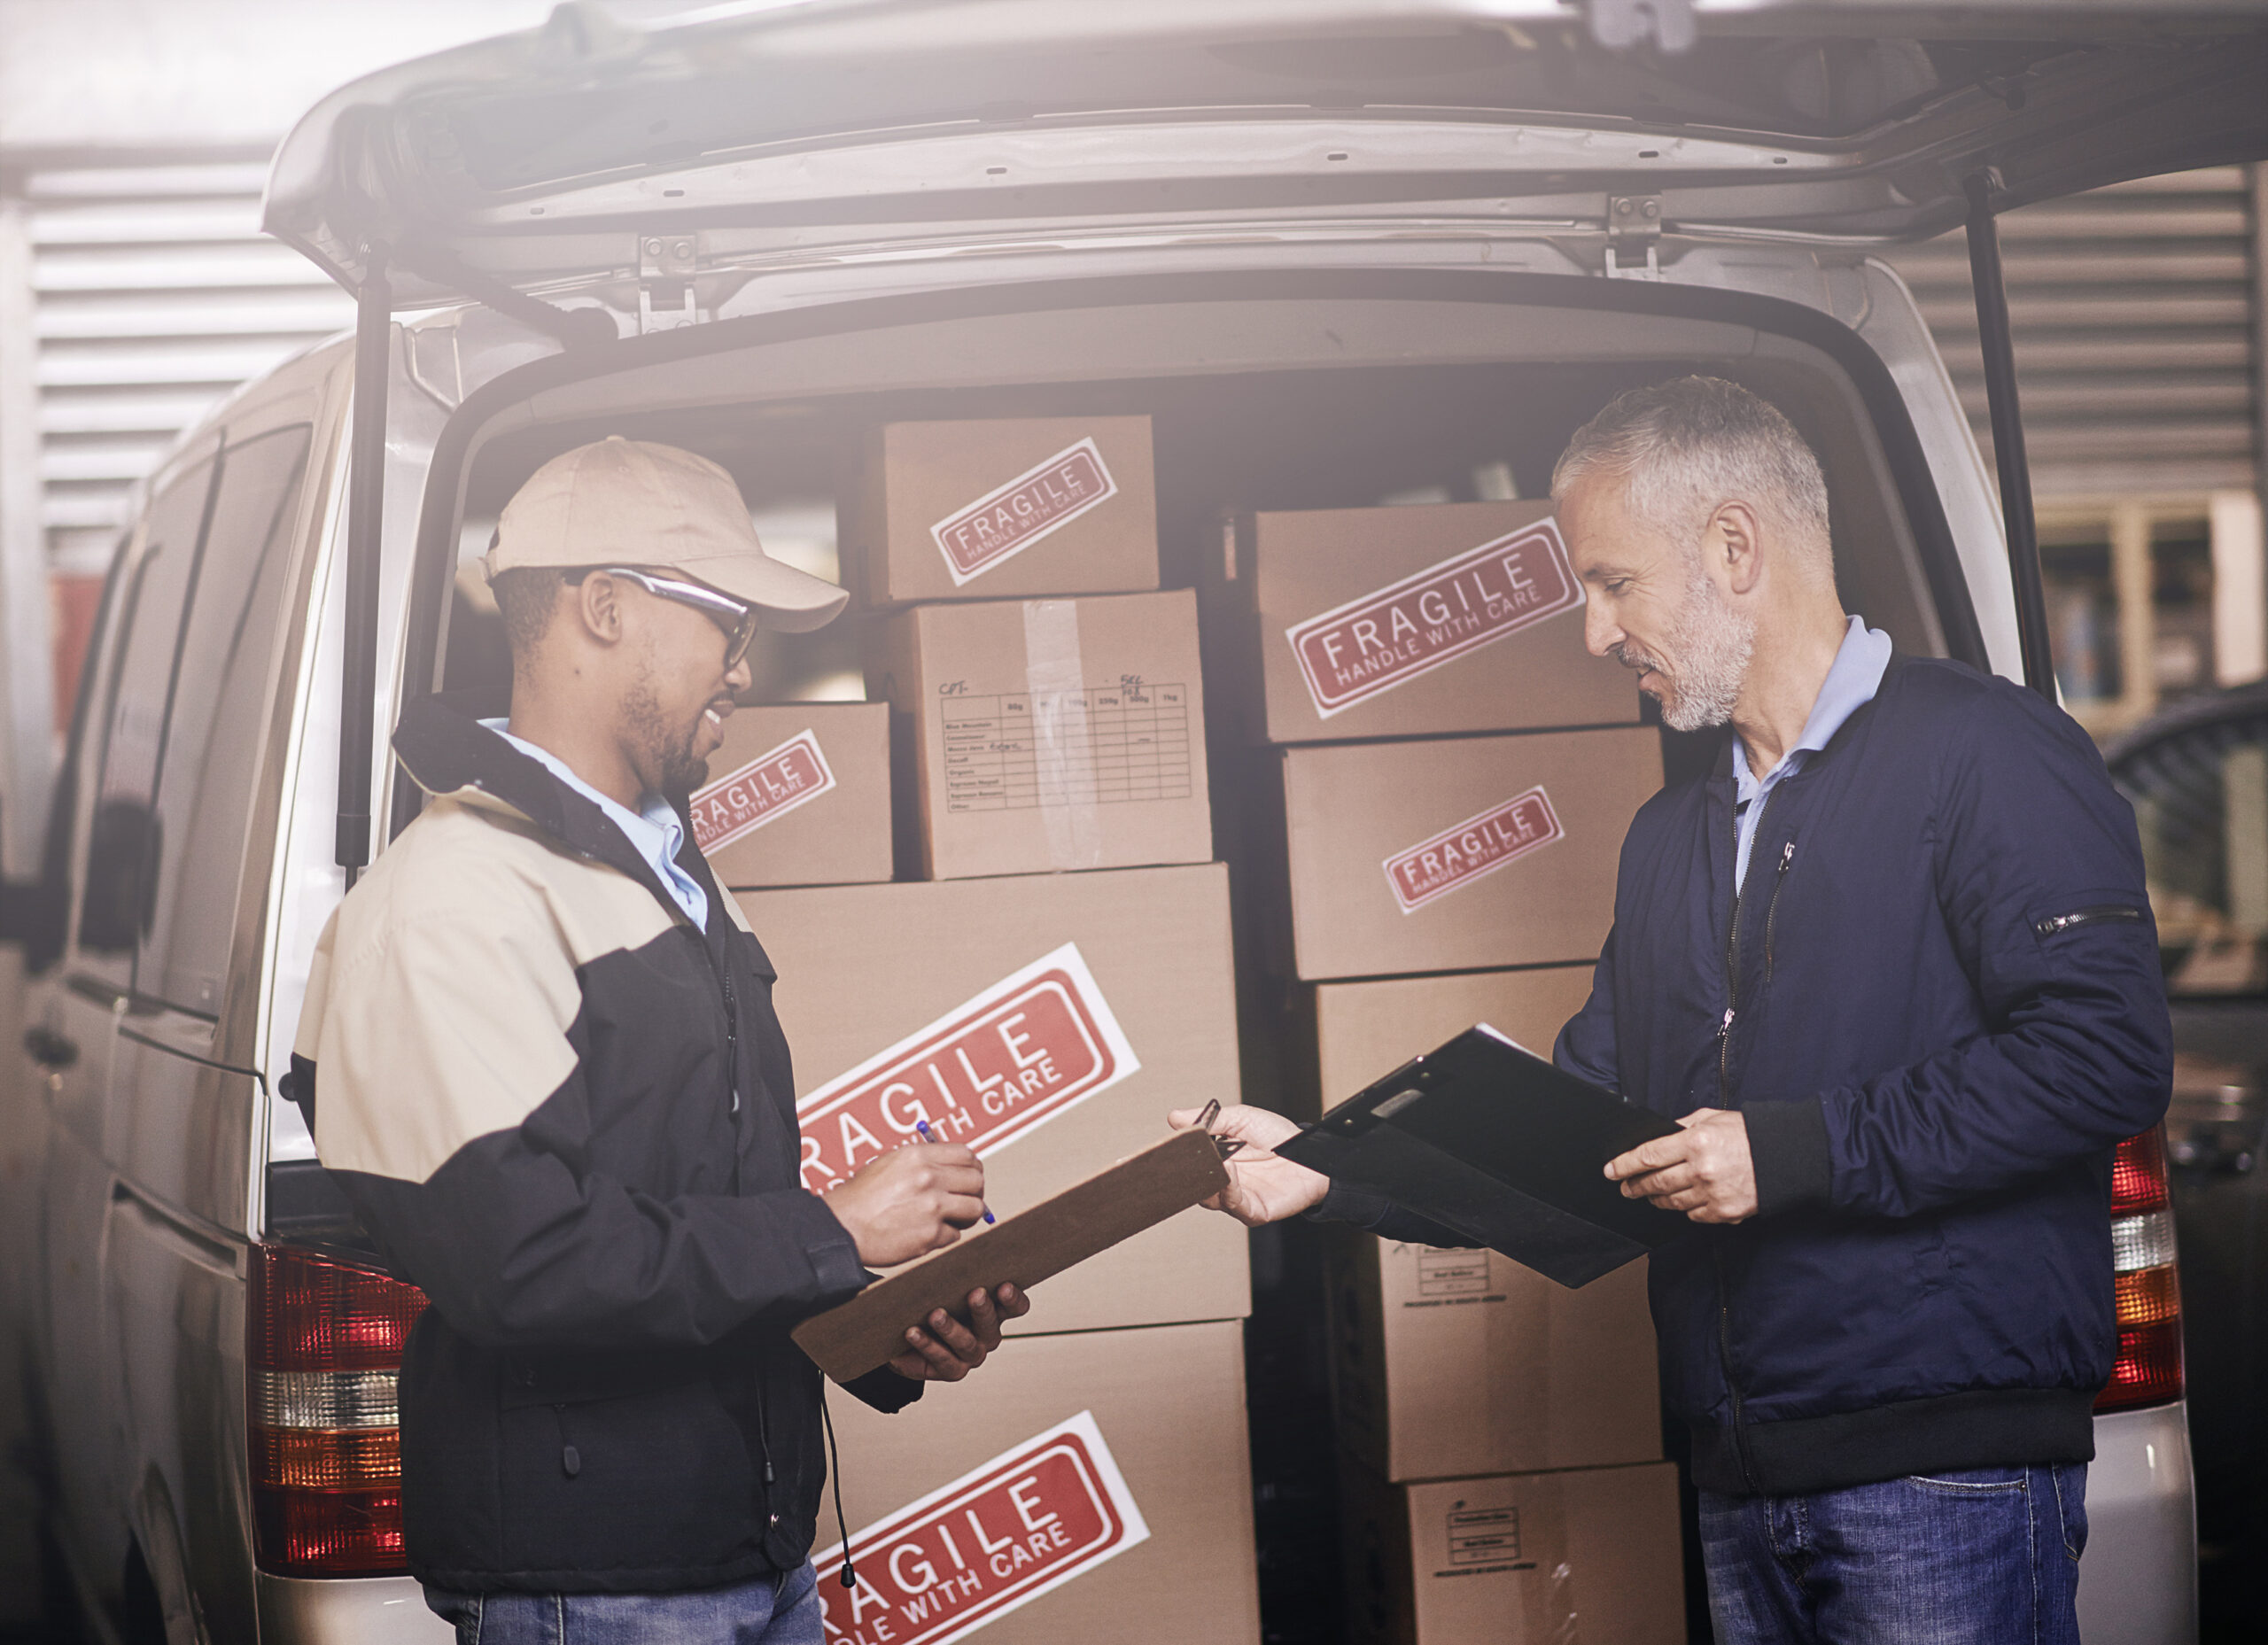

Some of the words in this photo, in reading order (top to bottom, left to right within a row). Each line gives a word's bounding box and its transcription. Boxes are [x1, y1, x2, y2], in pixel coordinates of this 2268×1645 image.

[955, 465, 1081, 550] FRAGILE
[967, 528, 1016, 560] HANDLE
[1019, 506, 1052, 529] WITH
[1054, 484, 1087, 508] CARE
[1322, 553, 1534, 669] FRAGILE
[1334, 638, 1420, 687] HANDLE
[1426, 613, 1480, 646] WITH
[1487, 585, 1542, 619] CARE
[691, 757, 800, 832] RAGILE
[696, 819, 731, 842] NDLE
[734, 796, 769, 821] WITH
[771, 776, 806, 801] CARE
[1402, 807, 1532, 884] FRAGILE
[1467, 844, 1500, 866] WITH
[801, 1013, 1047, 1189] RAGILE
[981, 1057, 1062, 1115] CARE
[819, 1476, 1058, 1634] AGILE
[900, 1570, 983, 1625] WITH
[990, 1521, 1072, 1578] CARE
